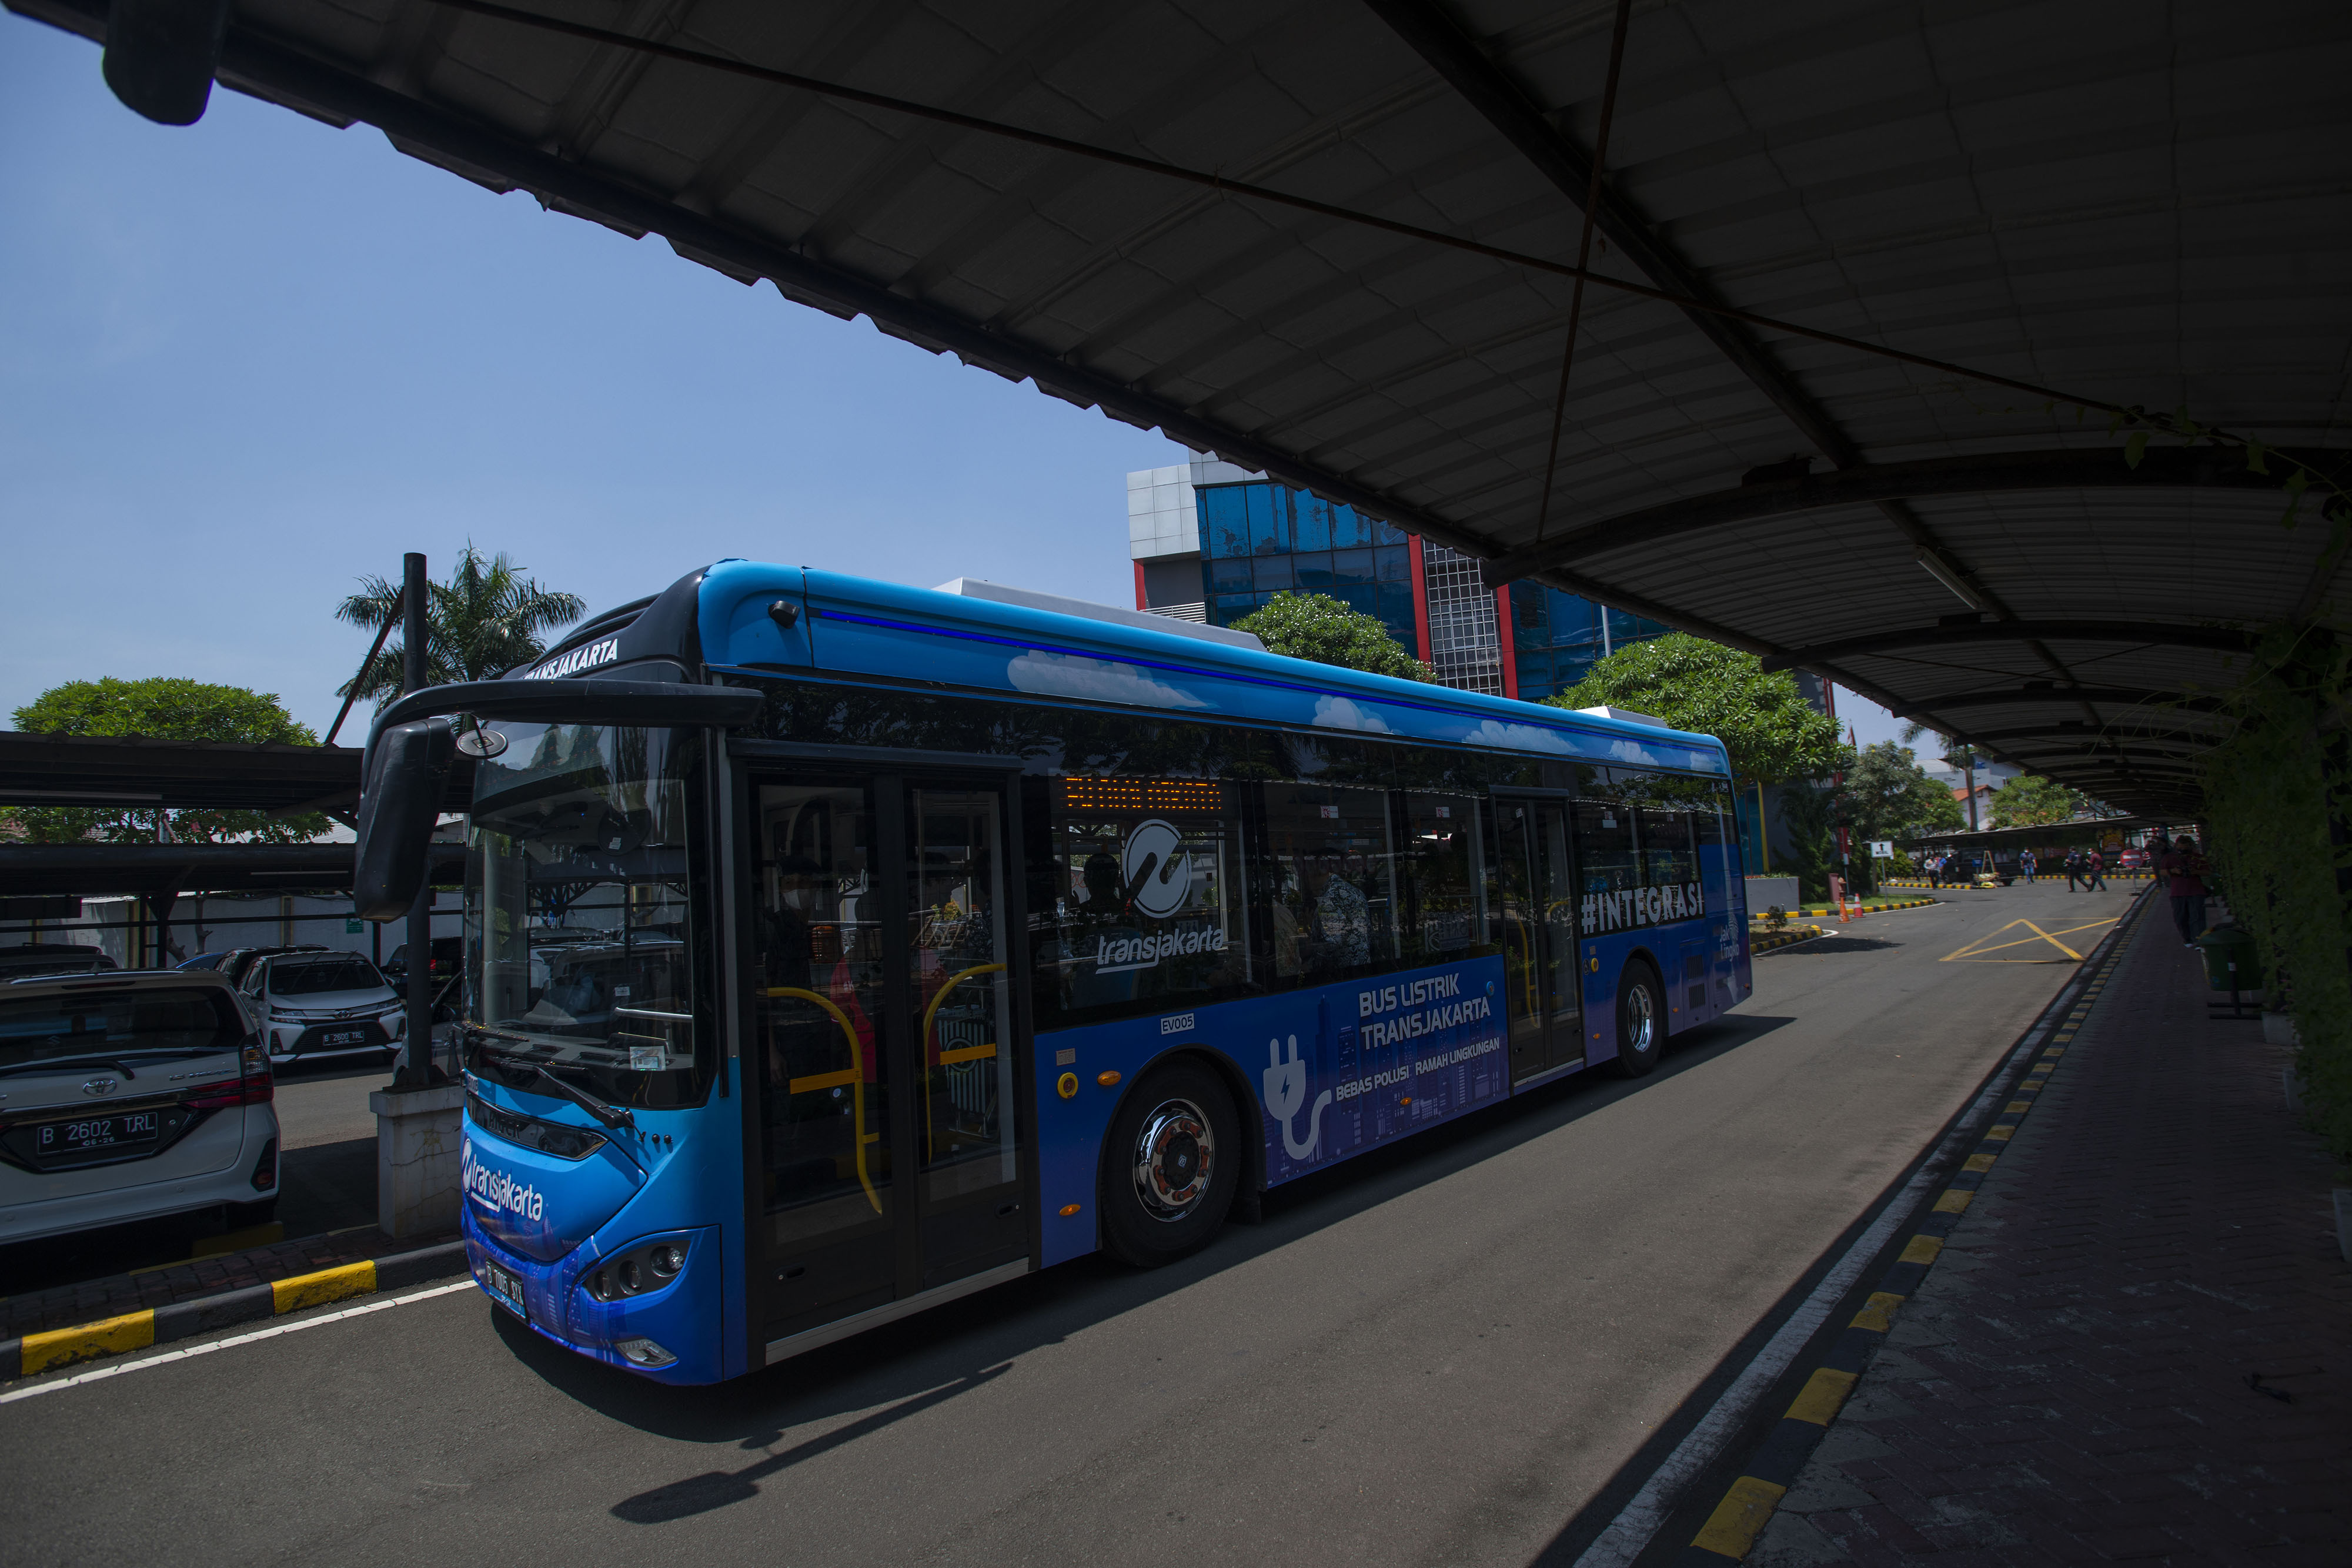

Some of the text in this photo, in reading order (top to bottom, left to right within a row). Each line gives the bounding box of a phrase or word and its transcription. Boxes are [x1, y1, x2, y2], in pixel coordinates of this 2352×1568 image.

[523, 638, 618, 680] ANSJAKARTA
[1581, 882, 1703, 934] #INTEGRASI
[1095, 924, 1224, 974] transjakarta
[1359, 972, 1461, 1017] BUS LISTRIK
[333, 1033, 349, 1041] 2600
[352, 1031, 363, 1039] TRL
[1162, 1016, 1193, 1031] EV005
[1361, 996, 1491, 1050] TRANSJAKARTA
[1336, 1037, 1500, 1101] BEBAS POLUSI RAMAH LINGKUNGAN
[42, 1115, 156, 1144] B 2602 TRL
[471, 1153, 543, 1222] transjakarta
[486, 1261, 493, 1284] B
